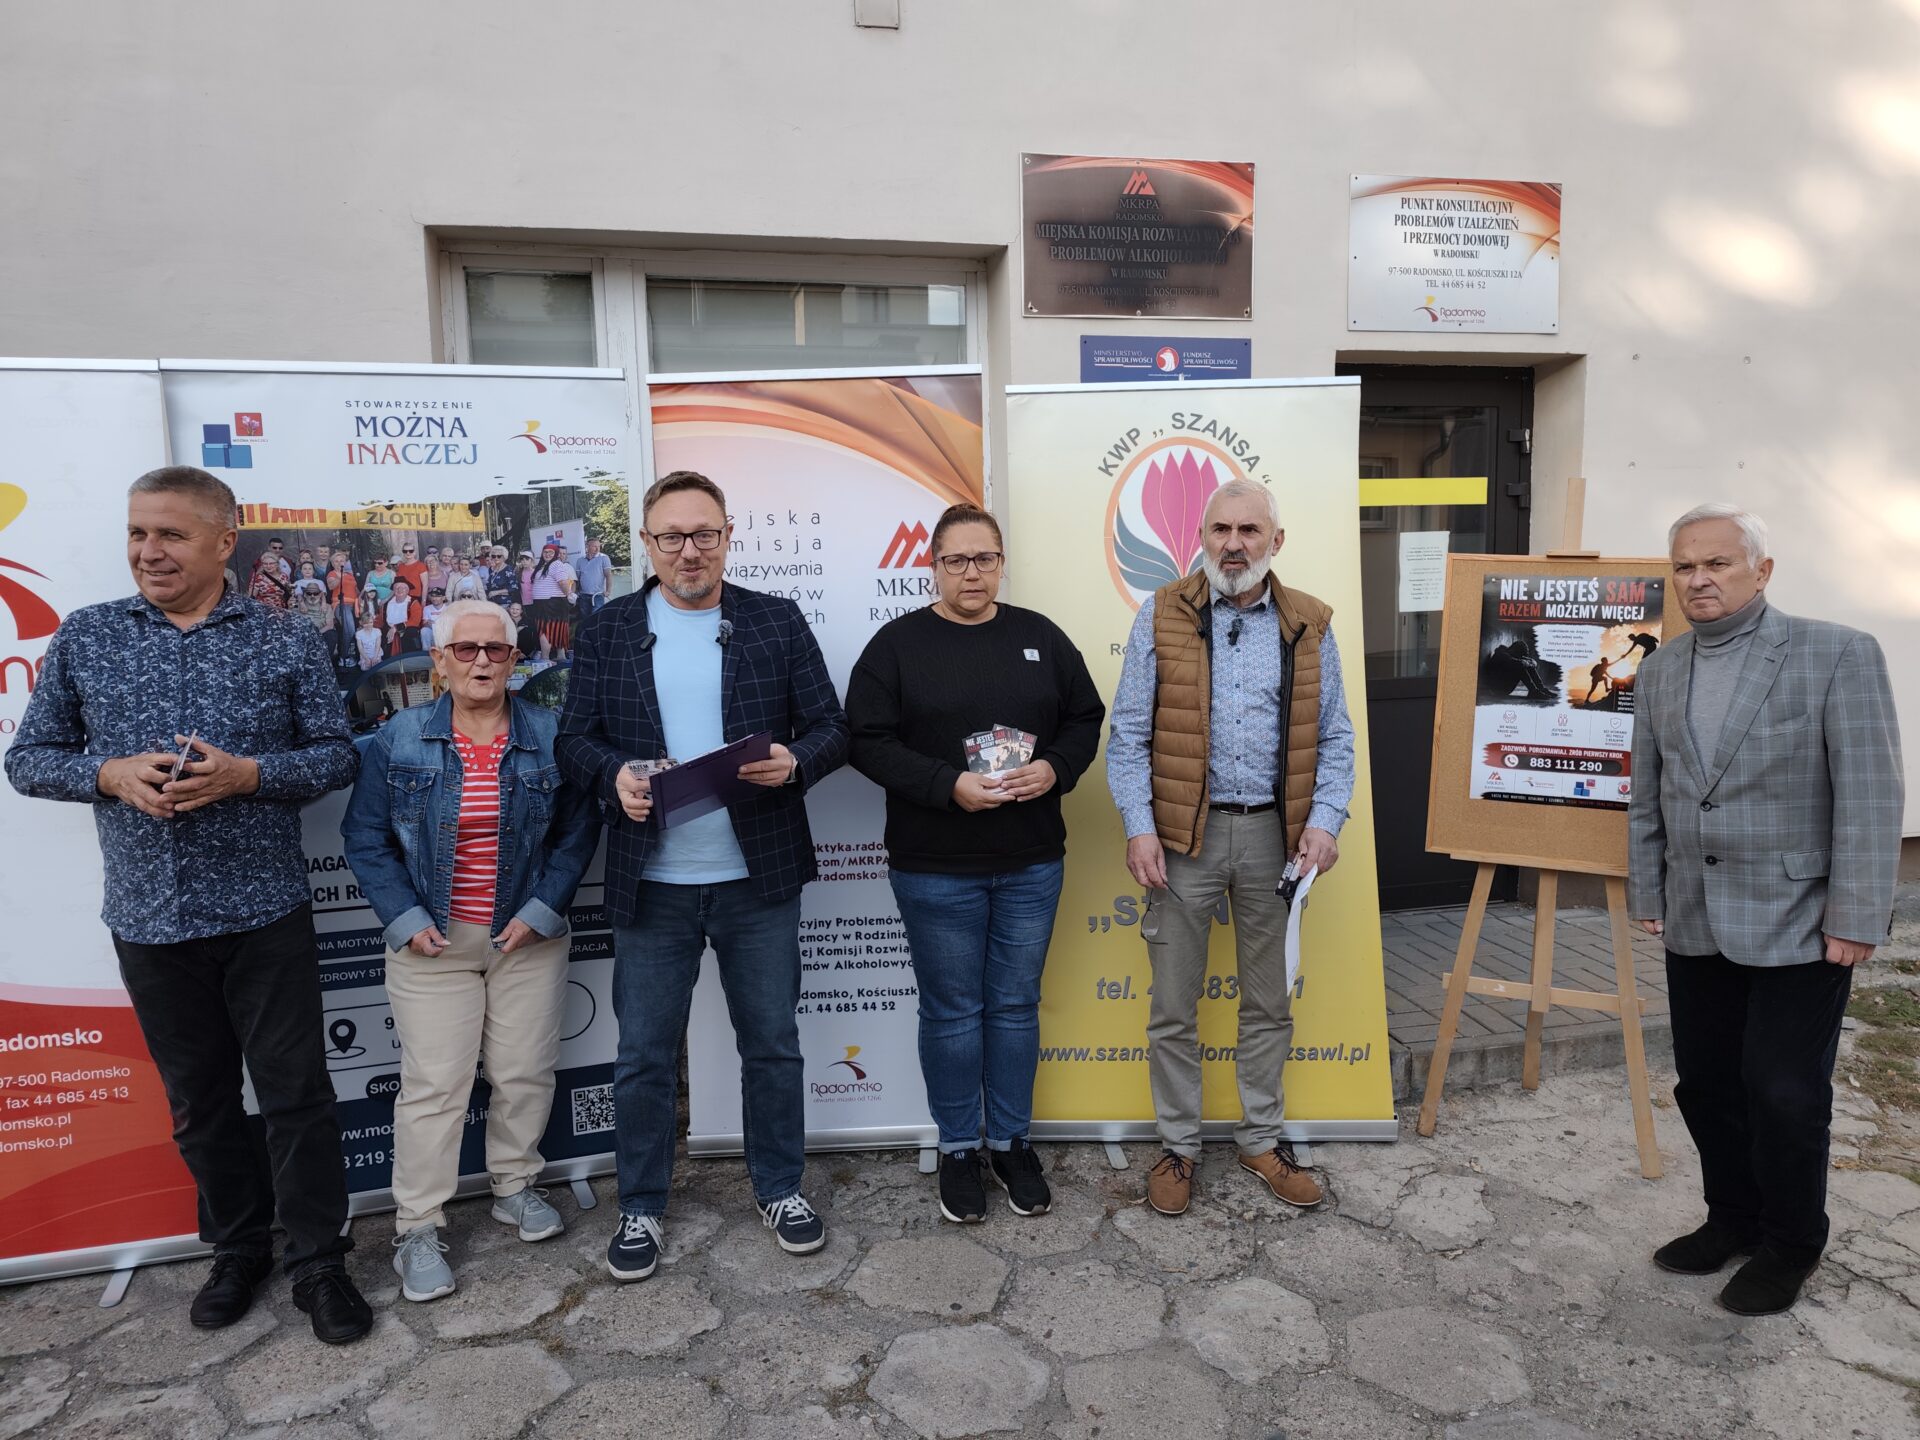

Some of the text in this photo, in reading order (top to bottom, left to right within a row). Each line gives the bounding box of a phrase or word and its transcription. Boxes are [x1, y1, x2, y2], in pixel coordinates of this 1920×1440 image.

[1120, 199, 1159, 209] MKRPA
[1401, 198, 1514, 215] PUNKT KONSULTACYJNY
[1395, 214, 1519, 230] PROBLEMÓW UZALEŻNIEŃ
[1036, 224, 1087, 240] MIEJSKA
[1089, 225, 1139, 243] KOMISJA
[1404, 232, 1509, 249] I PRZEMOCY DOMOWEJ
[1051, 244, 1127, 262] PROBLEMÓW
[1433, 249, 1479, 259] W RADOMSKU
[1111, 268, 1119, 278] W
[1389, 267, 1411, 275] 97-500
[1468, 268, 1509, 278] KOŚCIUSZKI
[1440, 307, 1486, 318] Radomsko
[345, 400, 473, 409] STOWARZYSZENIE
[355, 411, 468, 438] MOŻNA
[549, 435, 616, 448] Radomsko
[1098, 412, 1260, 477] KWP SZANSA
[347, 443, 478, 465] INACZEJ
[367, 512, 428, 526] ZLOTU
[1501, 577, 1646, 603] NIE JESTEŚ SAM
[1500, 602, 1644, 622] RAZEM MOŻEMY WIĘCEJ
[1530, 758, 1602, 771] 883 111 290
[799, 915, 902, 930] cyjny Problemów
[817, 946, 862, 957] Komisji
[803, 961, 829, 971] mów
[1097, 976, 1136, 999] tel.
[817, 1004, 831, 1013] 44
[836, 1003, 857, 1012] 685
[862, 1002, 877, 1011] 44
[881, 1001, 896, 1010] 52
[52, 1066, 130, 1083] Radomsko
[811, 1082, 882, 1097] Radomsko
[7, 1086, 128, 1109] fax 44 685 45 13
[355, 1151, 384, 1167] 219
